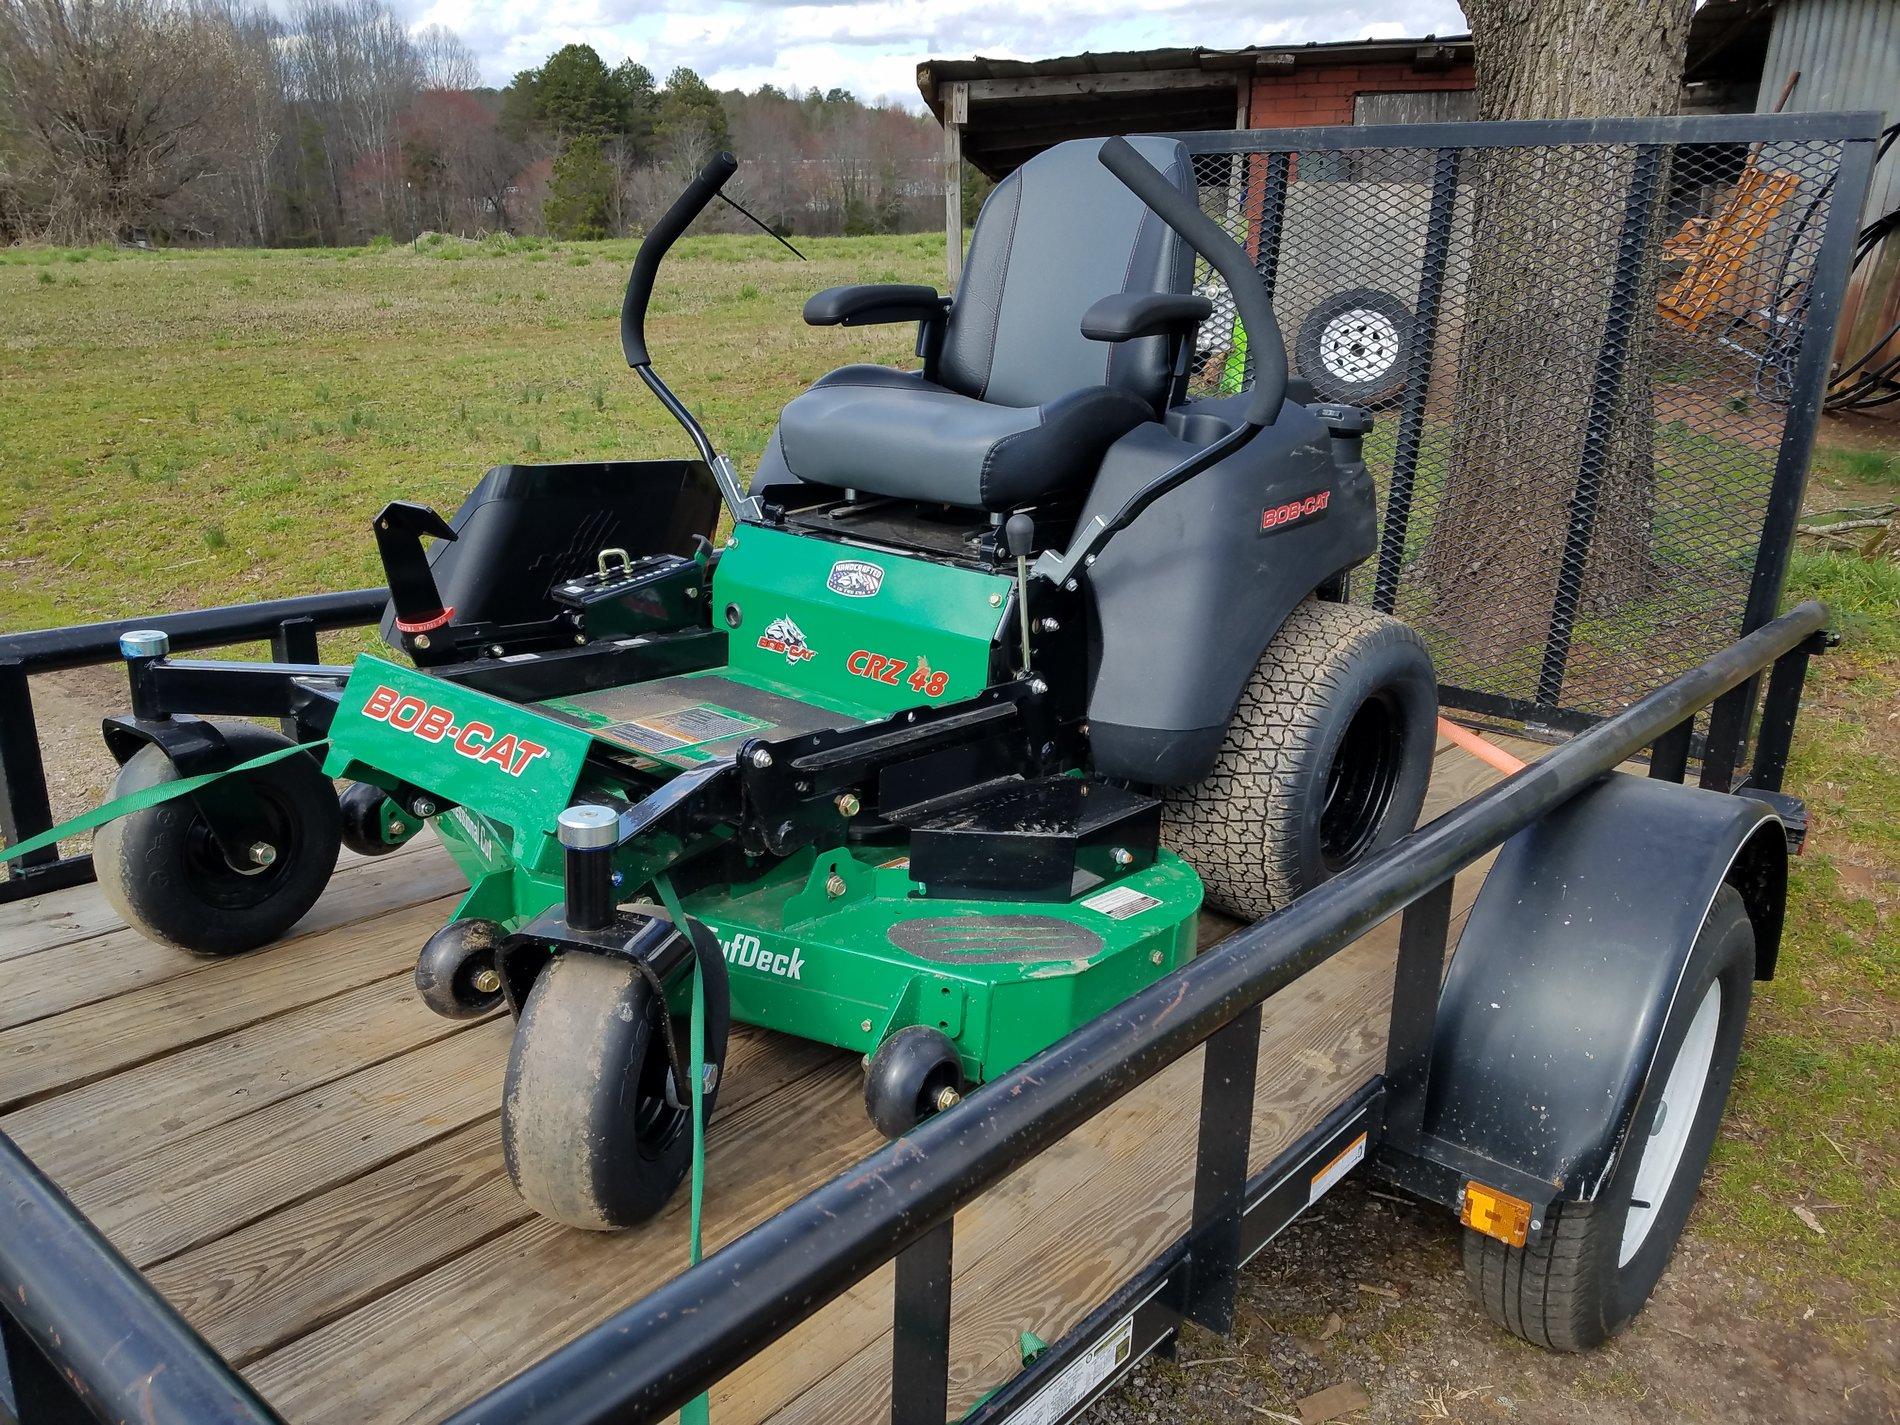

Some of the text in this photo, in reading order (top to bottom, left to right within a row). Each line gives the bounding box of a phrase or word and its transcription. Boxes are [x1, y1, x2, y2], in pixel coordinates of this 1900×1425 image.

[1262, 491, 1330, 528] BOB-CAT
[847, 650, 949, 697] CRZ 48
[361, 685, 547, 777] BOB-CAT
